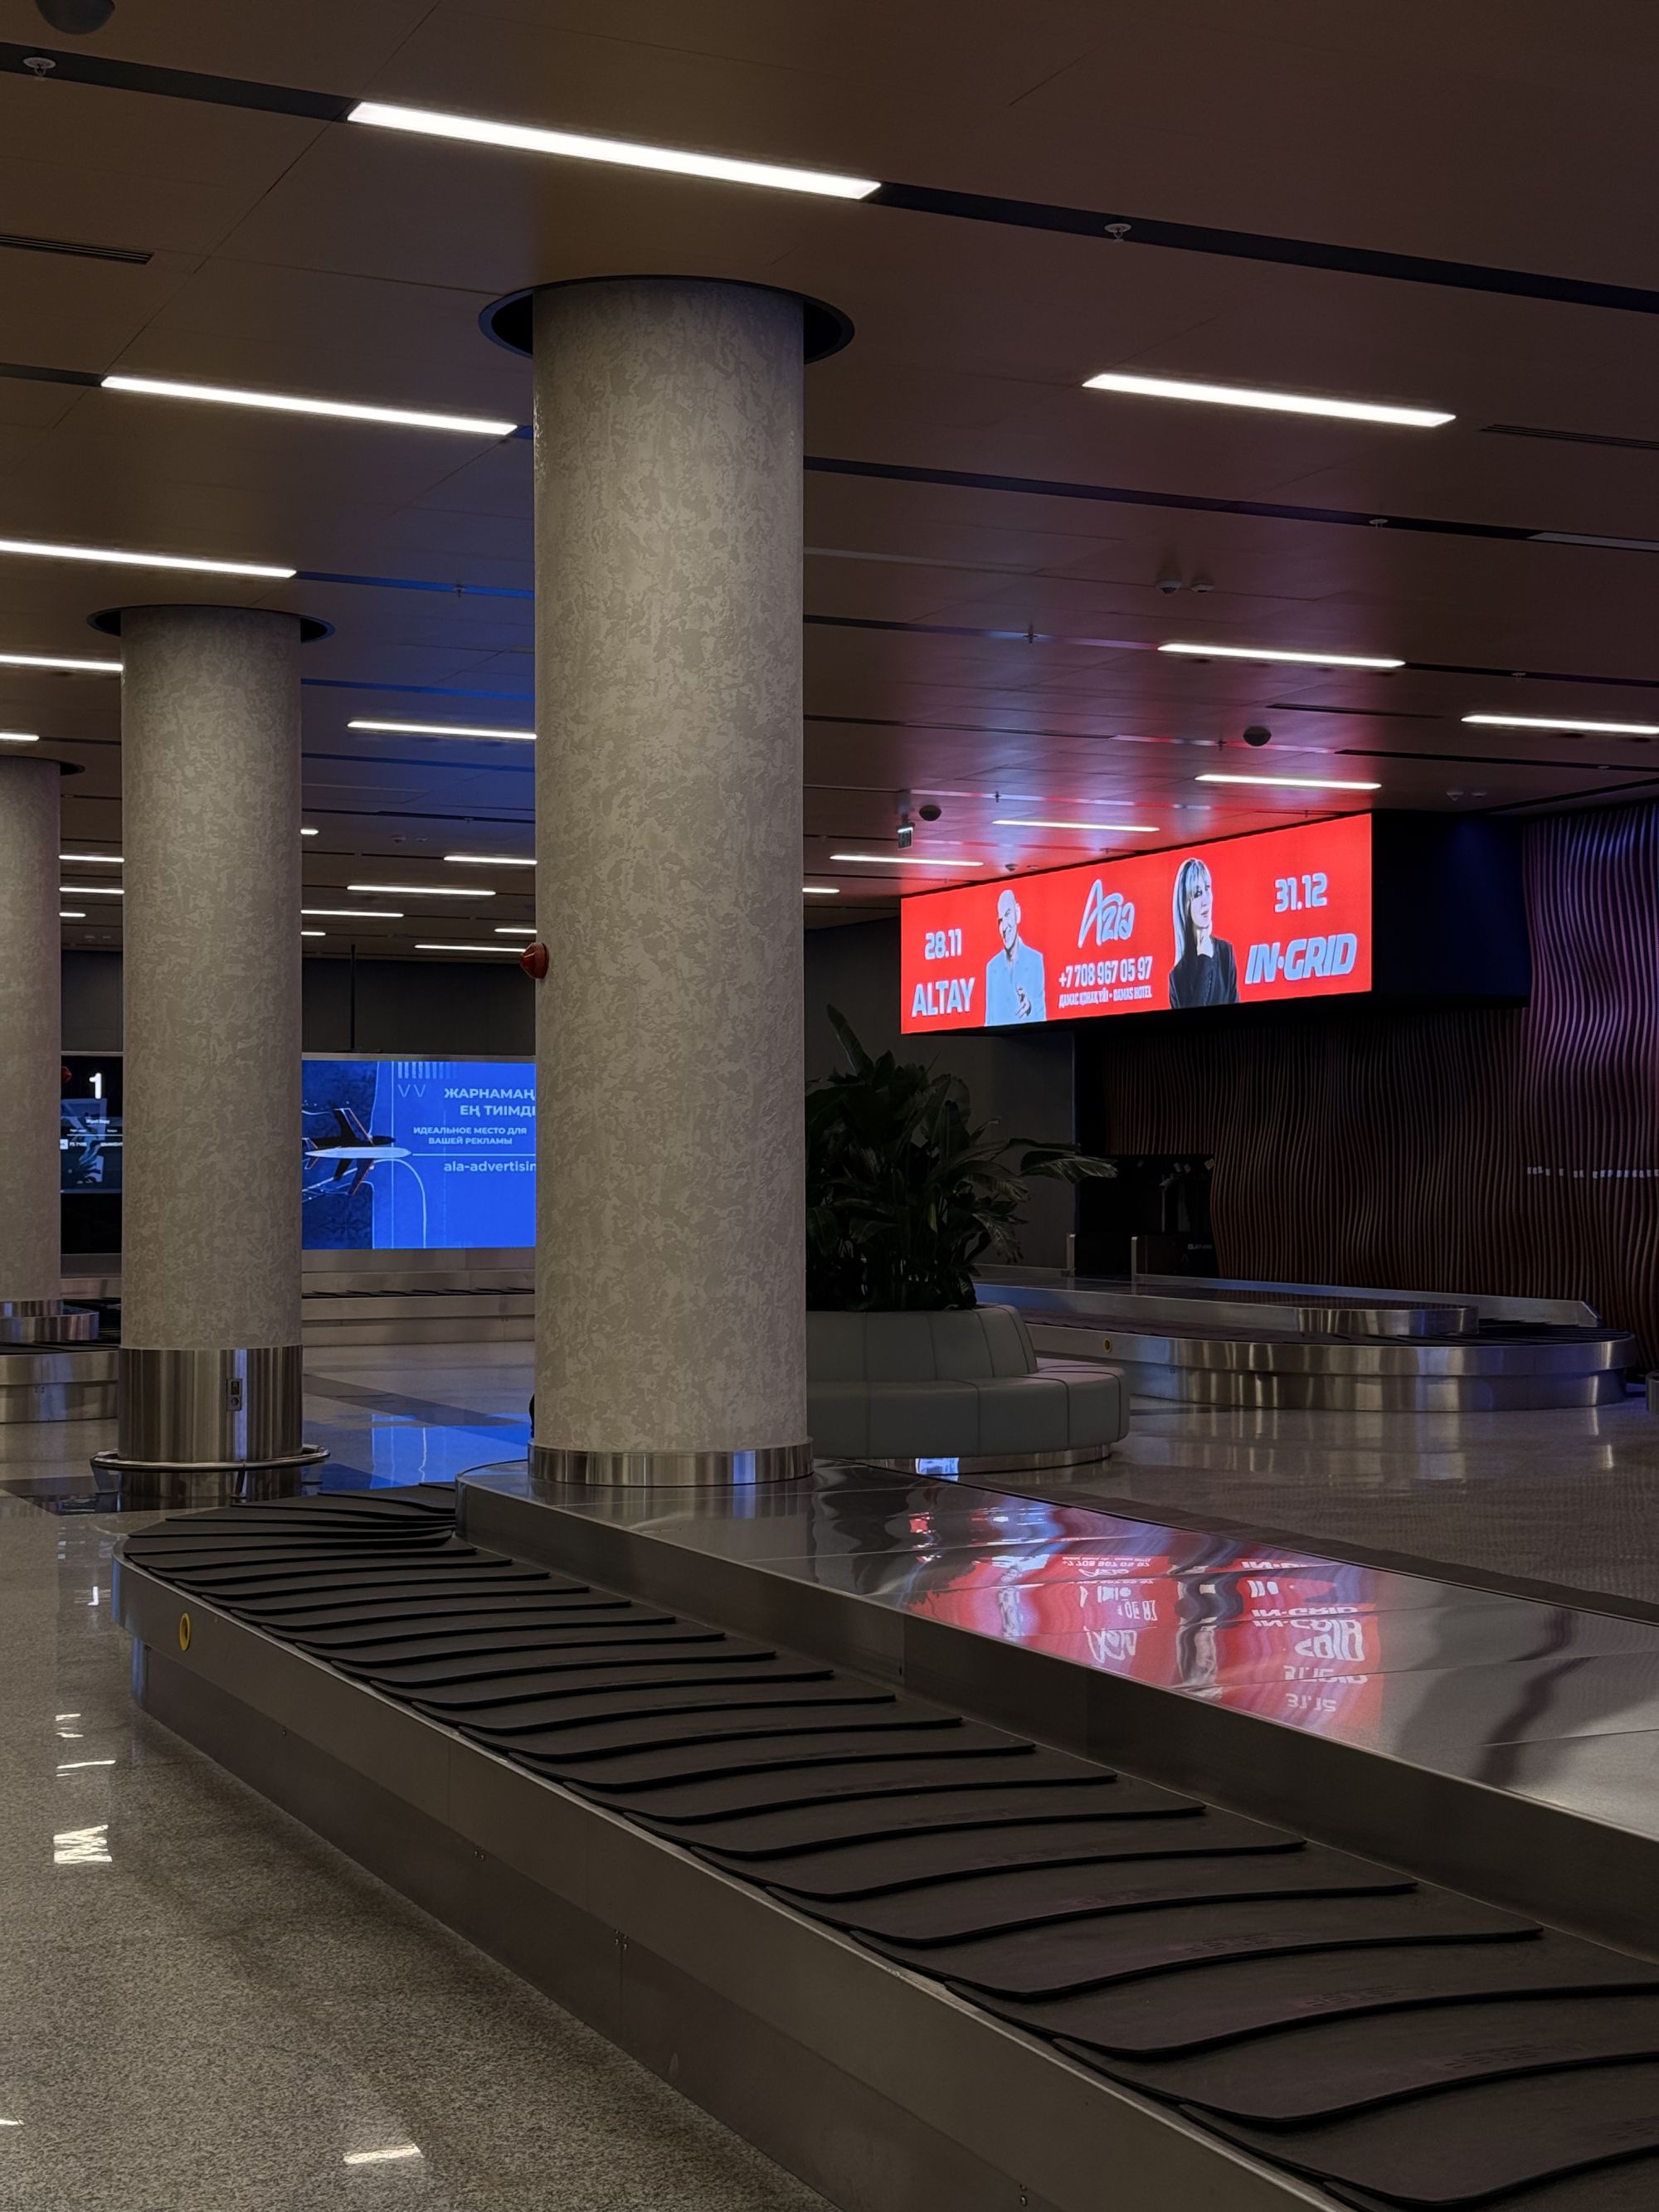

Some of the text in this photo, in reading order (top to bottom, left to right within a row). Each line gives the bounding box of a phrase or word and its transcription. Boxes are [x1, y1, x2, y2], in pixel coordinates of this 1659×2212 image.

[1274, 872, 1329, 913] 31.12
[924, 927, 963, 960] 28.11
[1058, 955, 1153, 988] +7 708 967 05 97
[911, 976, 976, 1018] ALTAY
[1134, 985, 1152, 999] HOTEL
[89, 1072, 102, 1100] 1
[460, 1105, 481, 1117] ЕҢ
[413, 1126, 472, 1135] ИДЕАЛЬНОЕ
[507, 1127, 528, 1135] ДЛЯ
[428, 1136, 464, 1145] ВАШЕЙ
